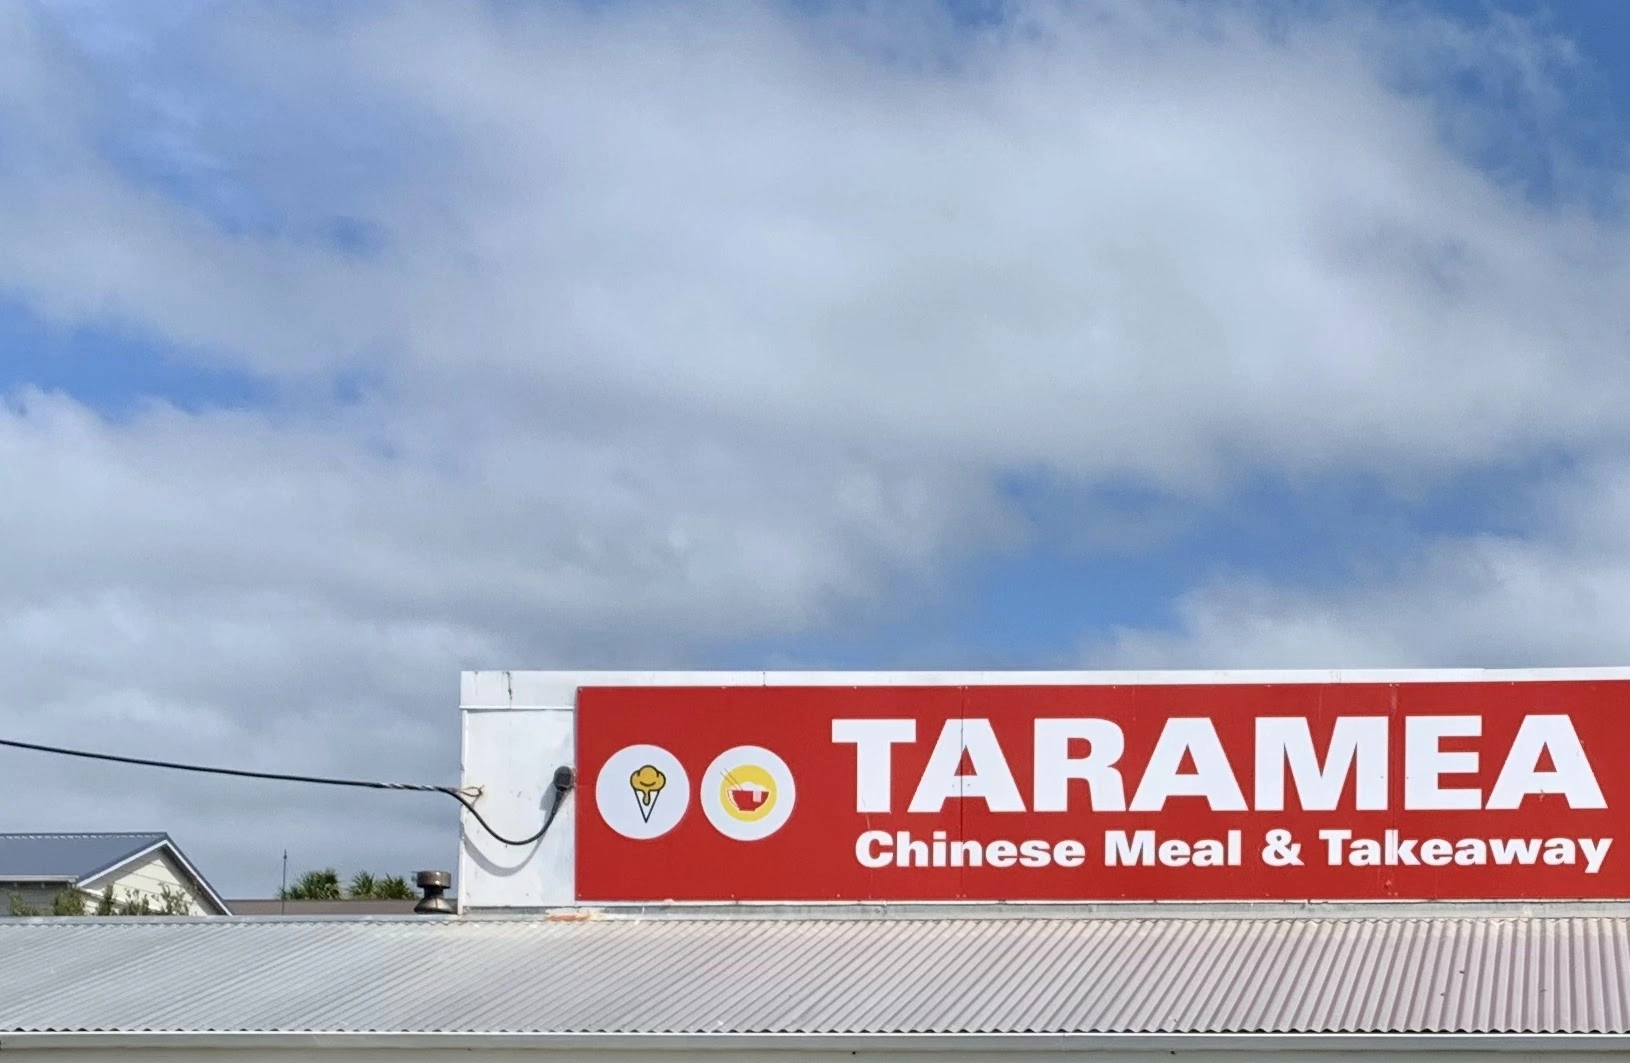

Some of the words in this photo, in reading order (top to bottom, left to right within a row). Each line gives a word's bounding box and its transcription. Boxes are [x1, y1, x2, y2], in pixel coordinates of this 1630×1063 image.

[831, 714, 1608, 813] TARAMEA
[855, 830, 1086, 868] Chinese
[1104, 829, 1242, 867] Meal
[1261, 829, 1305, 867] &
[1318, 829, 1613, 874] Takeaway
